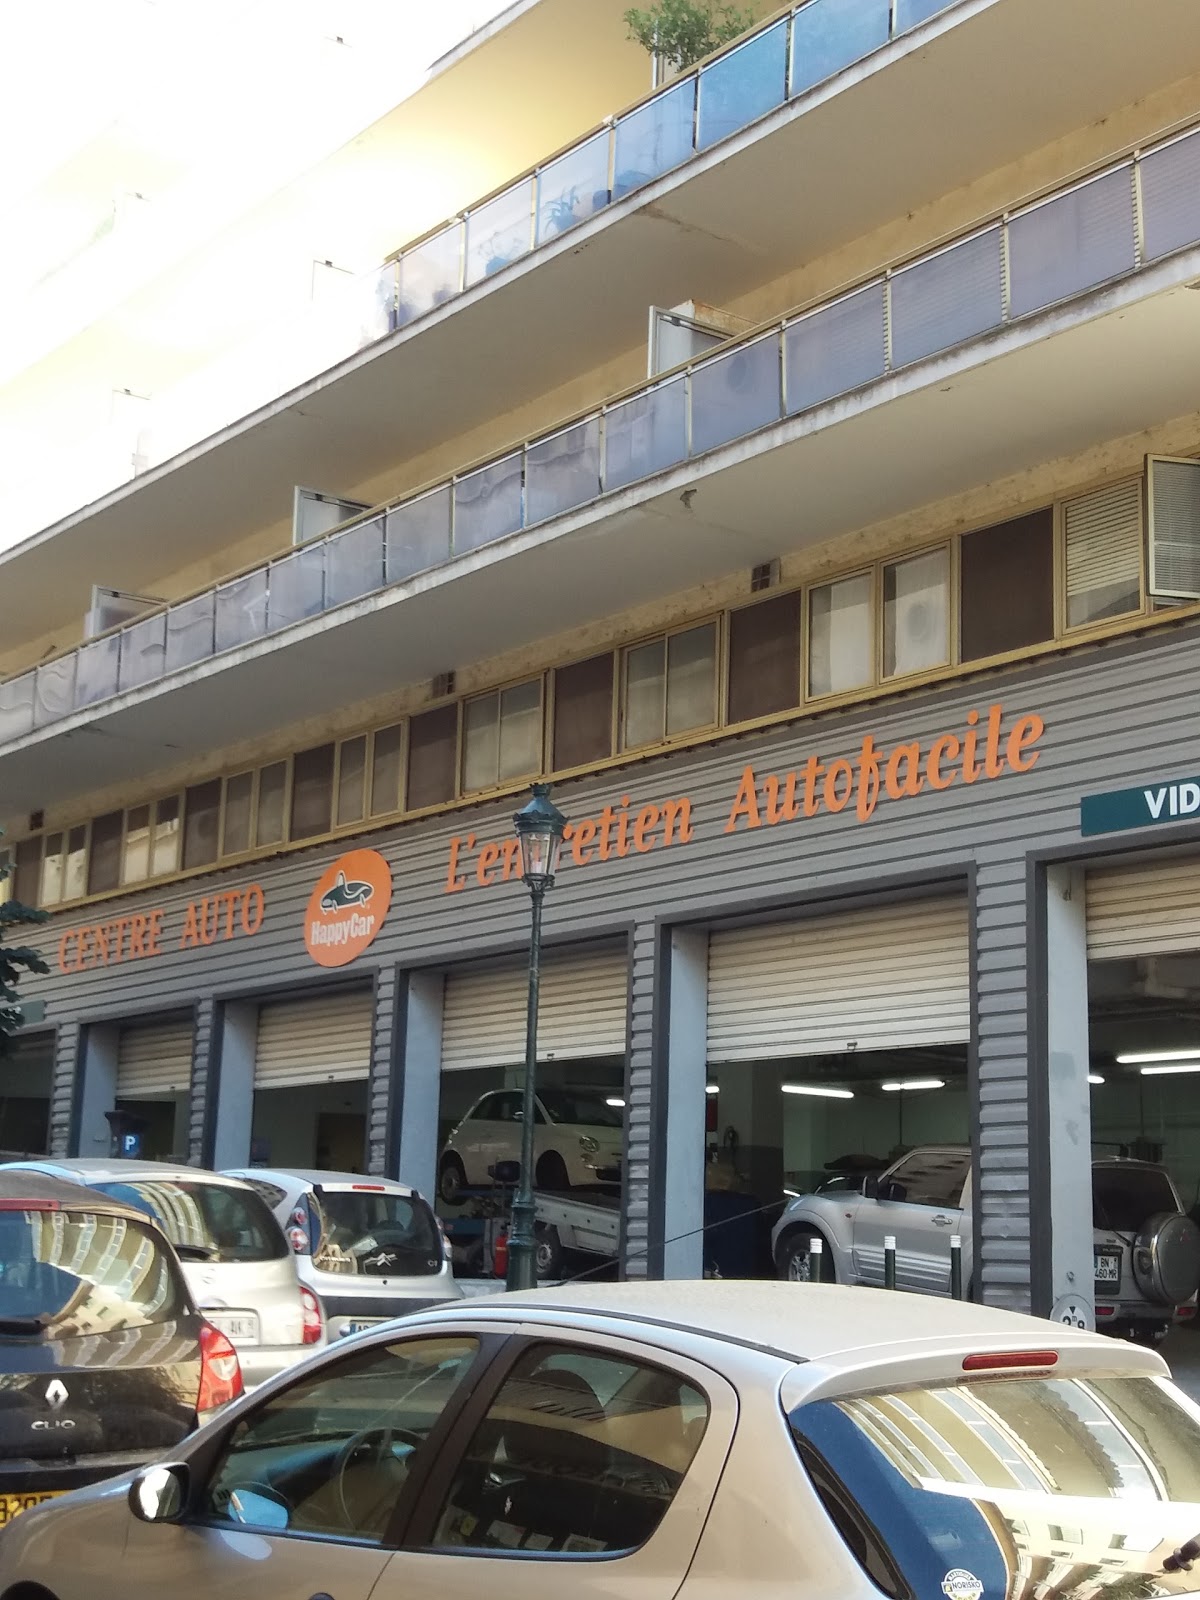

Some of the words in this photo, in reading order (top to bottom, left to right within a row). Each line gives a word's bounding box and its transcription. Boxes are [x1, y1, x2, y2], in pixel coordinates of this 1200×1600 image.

[445, 794, 694, 893] L'enetien
[724, 703, 1044, 832] Autofacile
[1144, 783, 1200, 819] VID
[58, 909, 164, 974] CENTRE
[179, 884, 264, 949] AUTO
[311, 913, 375, 947] HappyCar
[125, 1135, 136, 1151] P
[31, 1420, 76, 1430] CLIO
